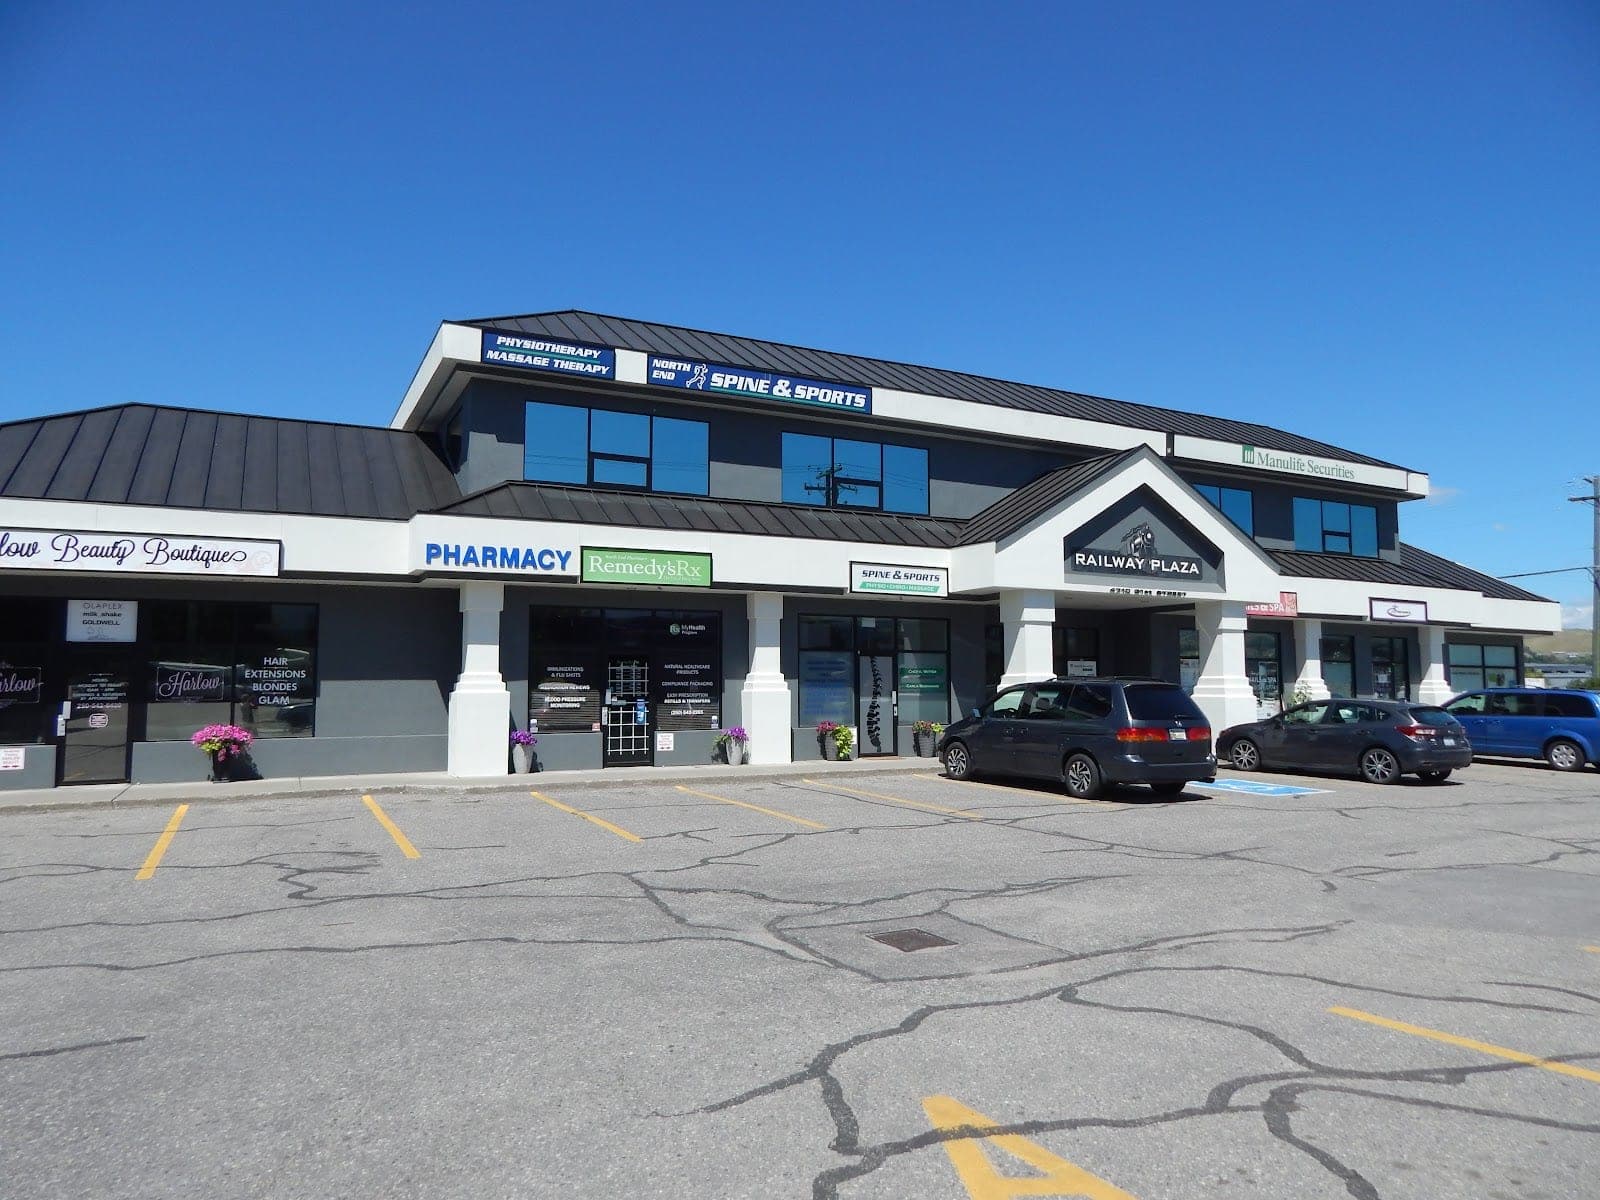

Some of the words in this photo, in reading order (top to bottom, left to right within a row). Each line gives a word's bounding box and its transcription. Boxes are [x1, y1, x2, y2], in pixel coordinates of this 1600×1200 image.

[496, 335, 602, 359] PHYSIOTHERAPY
[486, 350, 550, 367] MASSAGE
[553, 359, 610, 375] THERAPY
[652, 358, 691, 372] NORTH
[652, 369, 676, 381] END
[710, 372, 771, 394] SPINE
[772, 378, 792, 398] &
[794, 385, 867, 408] SPORTS
[1257, 451, 1305, 472] Manulife
[1307, 459, 1355, 480] Securities
[51, 534, 136, 566] Beauty
[143, 537, 247, 569] Boutique
[425, 543, 572, 572] PHARMACY
[588, 554, 703, 580] Remedy'sRx
[1075, 553, 1145, 570] RAILWAY
[1151, 559, 1200, 575] PLAZA
[861, 569, 891, 579] SPINE
[892, 570, 902, 580] &
[903, 572, 941, 582] SPORTS
[82, 602, 123, 610] OLAPLEX
[1269, 603, 1285, 612] SPA
[263, 656, 289, 667] HAIR
[244, 669, 306, 680] EXTENSIONS
[158, 671, 222, 697] Harlow
[252, 682, 298, 692] BLONDES
[258, 695, 290, 706] GLAM
